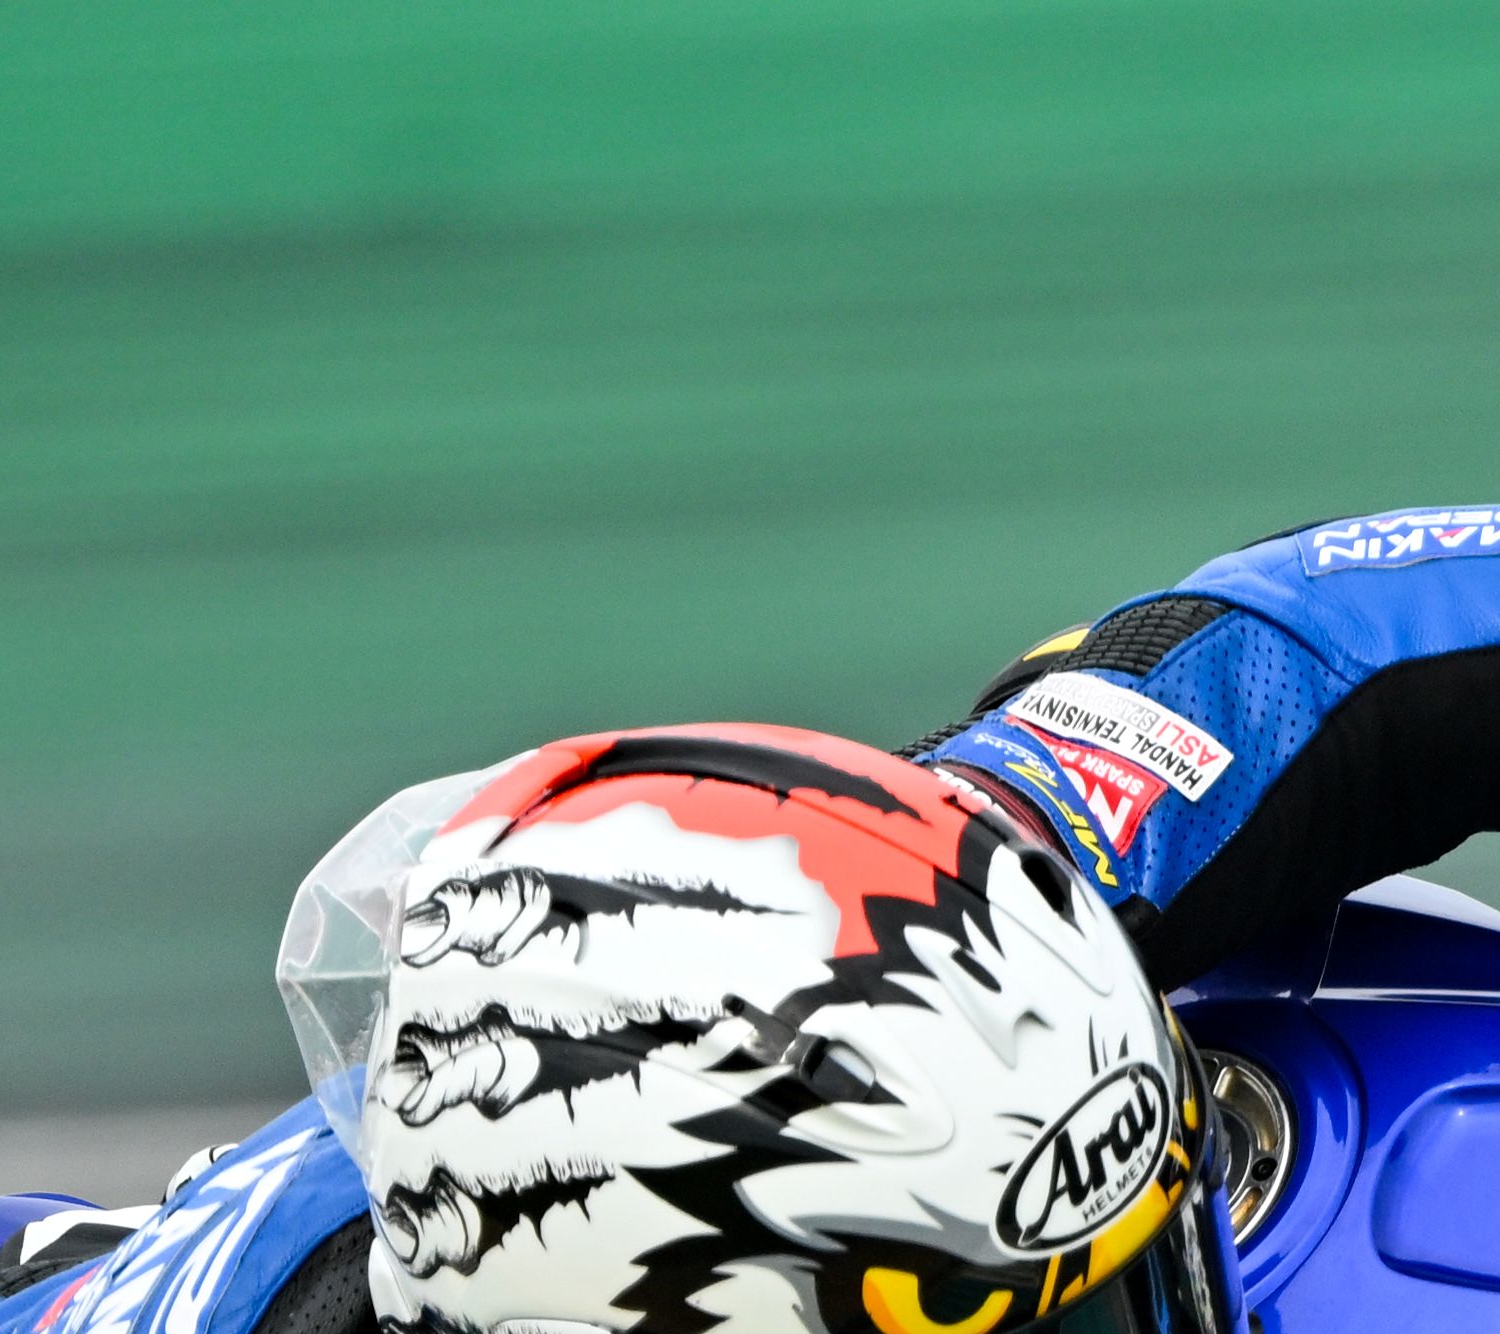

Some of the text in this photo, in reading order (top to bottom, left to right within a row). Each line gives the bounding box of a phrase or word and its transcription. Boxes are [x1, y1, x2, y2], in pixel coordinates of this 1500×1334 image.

[1131, 733, 1203, 790] HANDAL
[1156, 721, 1221, 767] ASLI
[1078, 758, 1145, 796] SPARK
[1018, 1080, 1158, 1240] Arai
